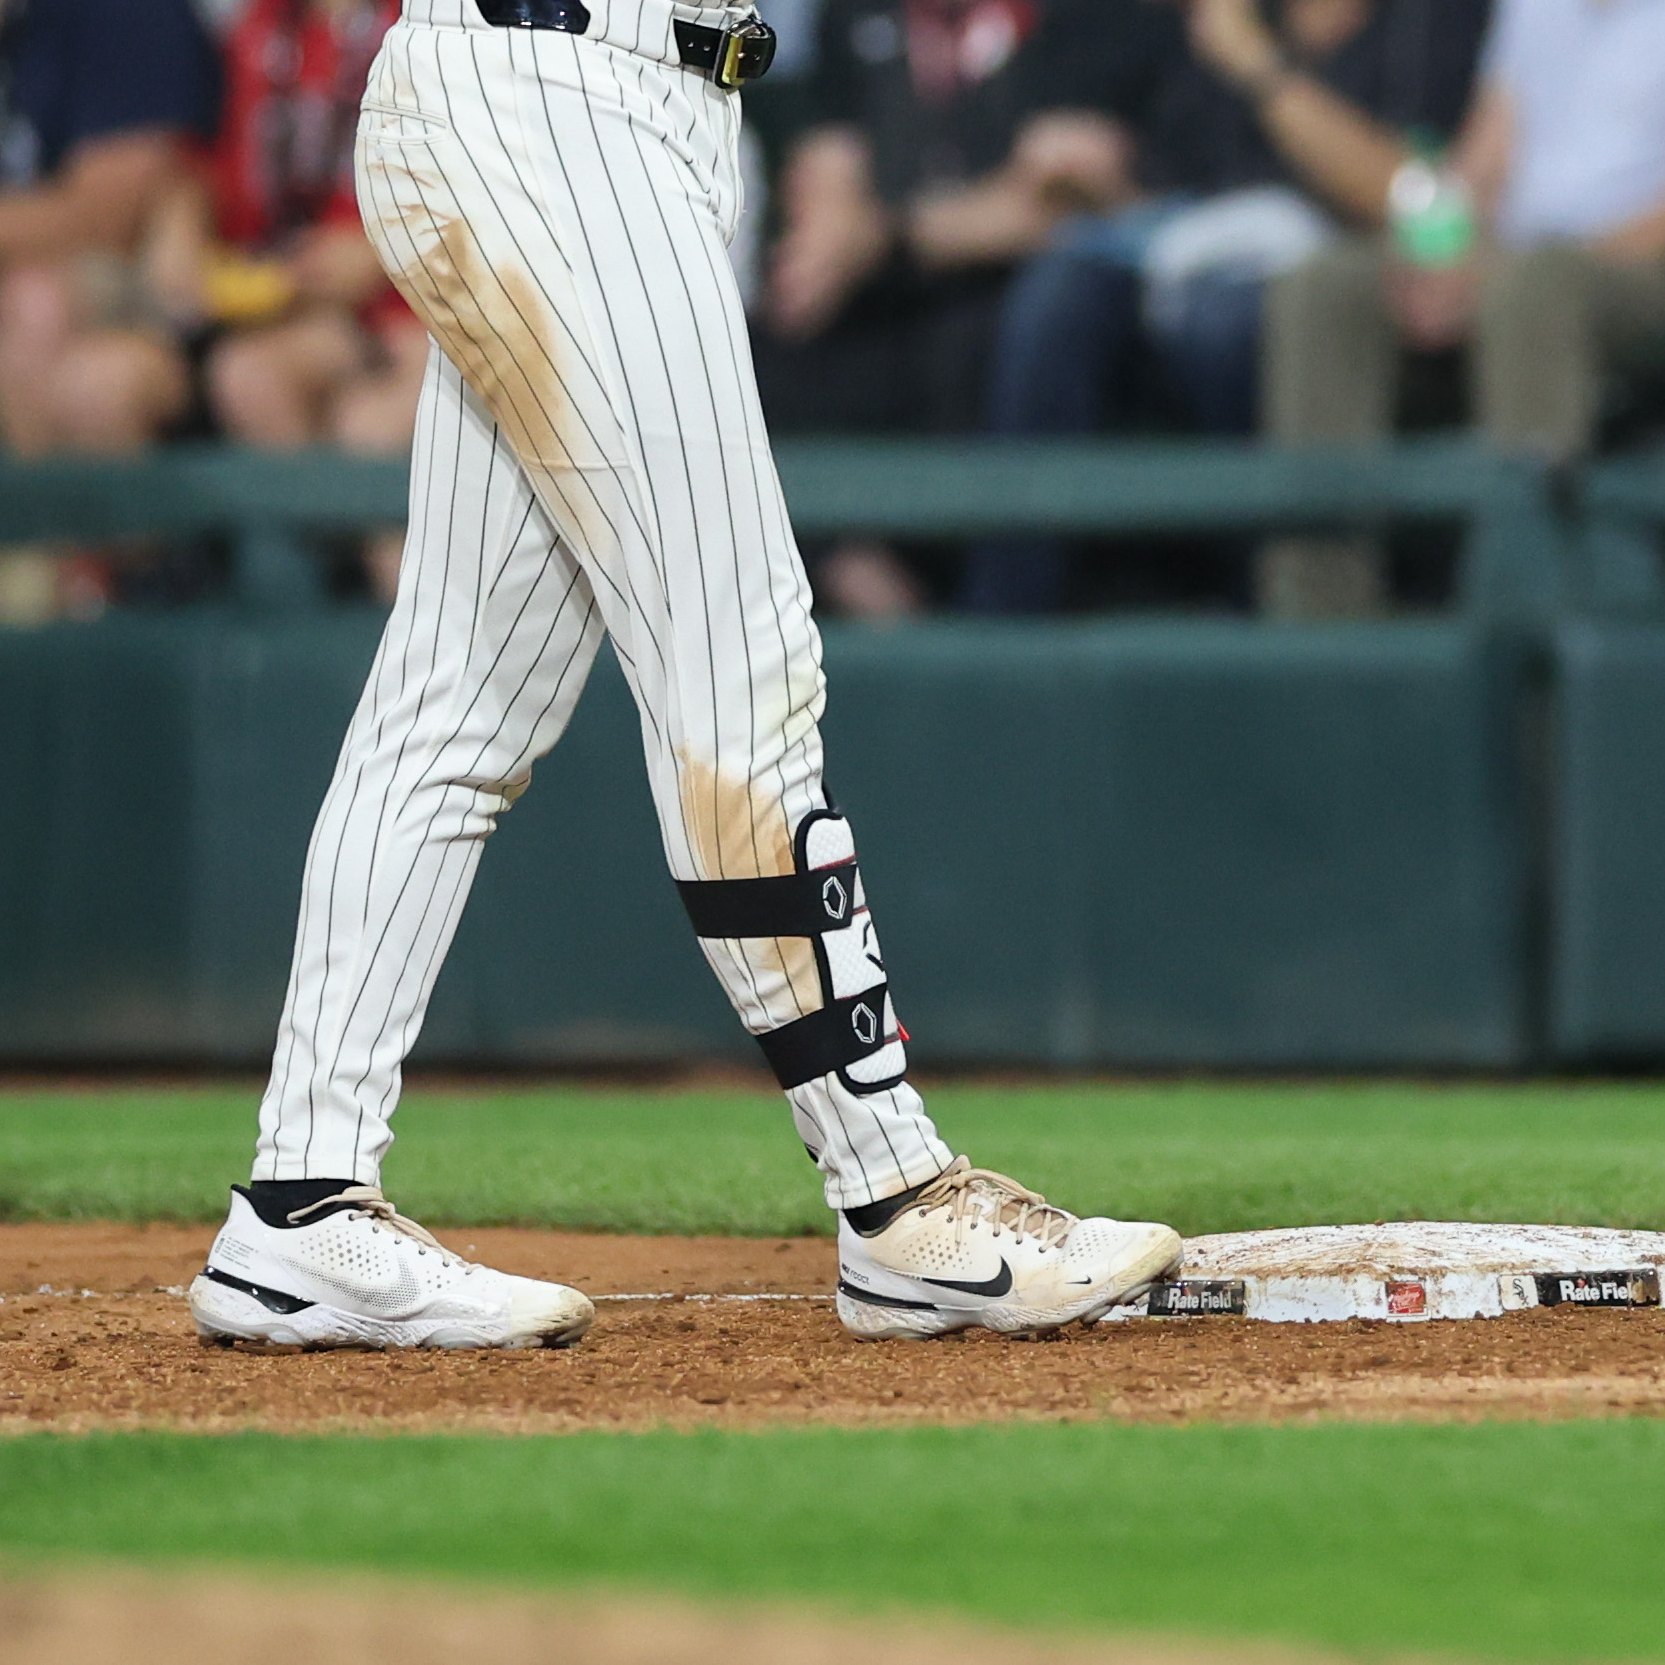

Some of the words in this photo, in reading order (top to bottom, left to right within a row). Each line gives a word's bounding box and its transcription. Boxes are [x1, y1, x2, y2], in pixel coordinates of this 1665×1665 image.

[1167, 1287, 1199, 1309] Rate
[1200, 1287, 1232, 1309] Field
[1558, 1279, 1601, 1302] Rate
[1601, 1281, 1644, 1303] Fiel
